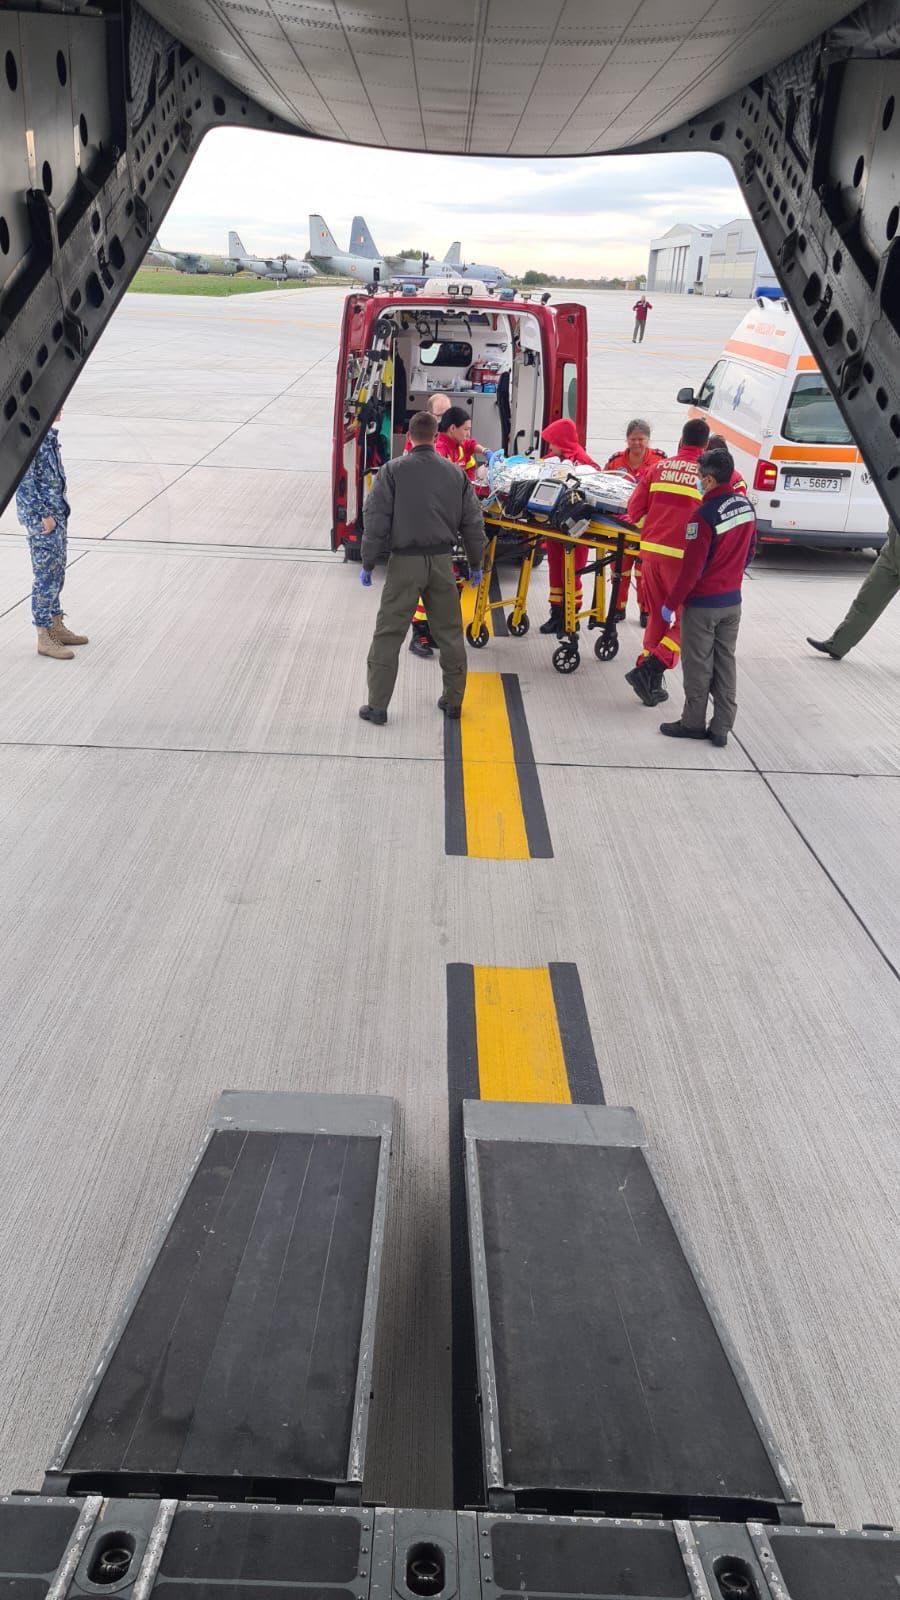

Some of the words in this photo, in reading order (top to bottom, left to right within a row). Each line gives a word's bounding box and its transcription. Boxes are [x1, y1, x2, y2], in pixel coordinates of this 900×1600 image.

[657, 460, 699, 474] POMPIE
[660, 470, 698, 486] SMURD
[809, 478, 838, 489] 56873
